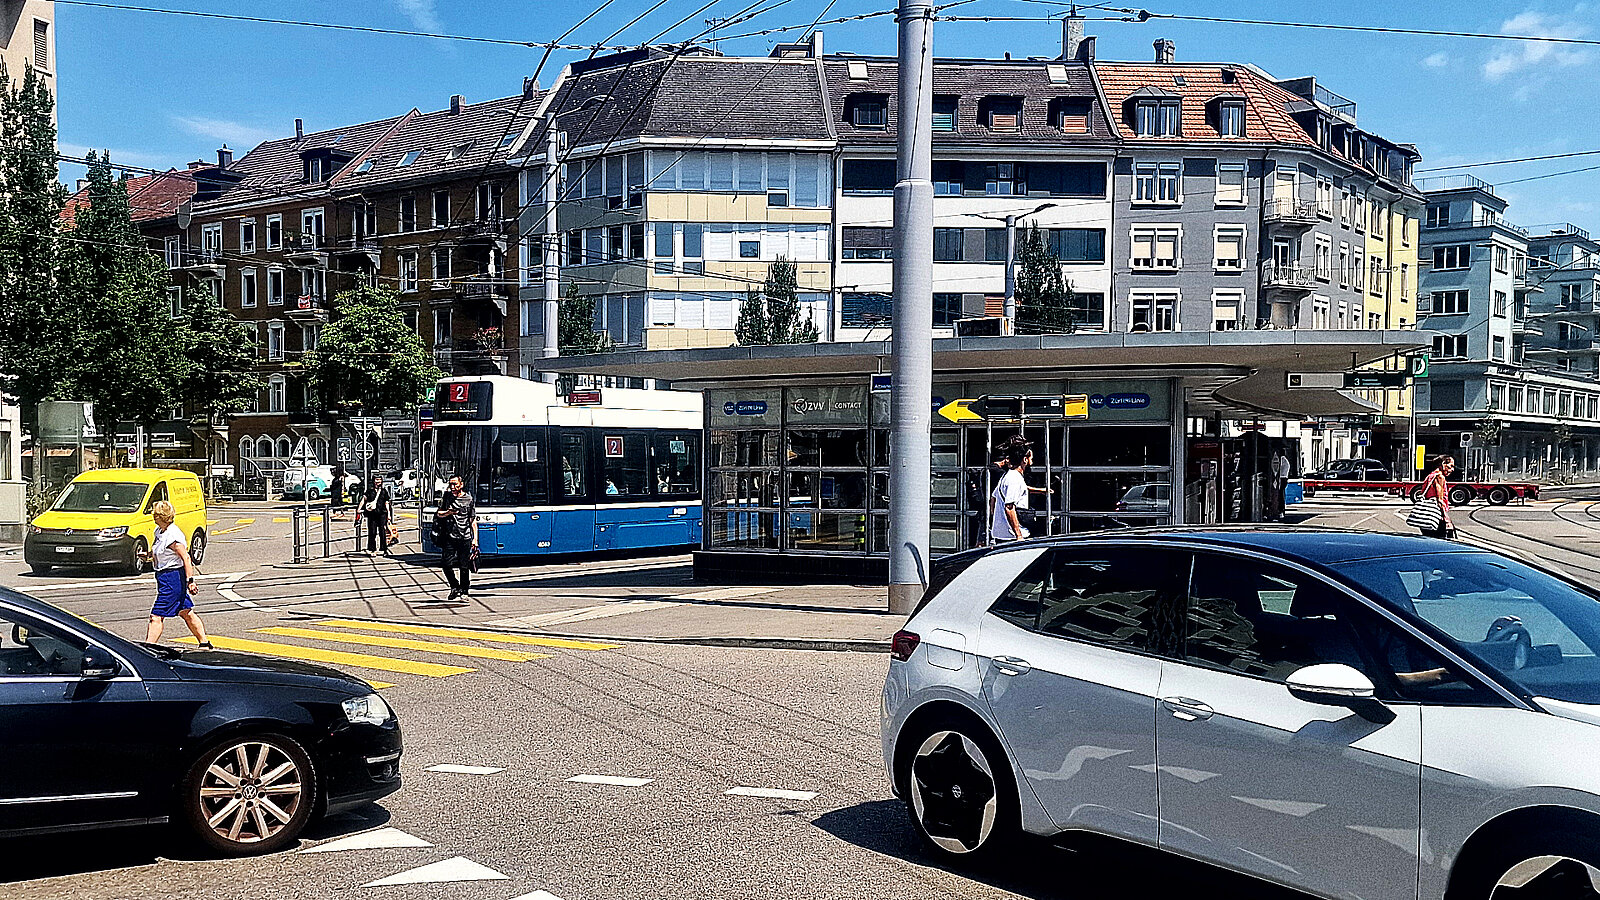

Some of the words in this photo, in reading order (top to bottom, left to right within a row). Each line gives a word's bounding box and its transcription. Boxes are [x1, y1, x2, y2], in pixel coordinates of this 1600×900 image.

[1354, 378, 1360, 386] 3
[428, 389, 436, 400] A
[456, 385, 464, 400] 2
[807, 402, 825, 411] ZVV
[610, 440, 618, 454] 2
